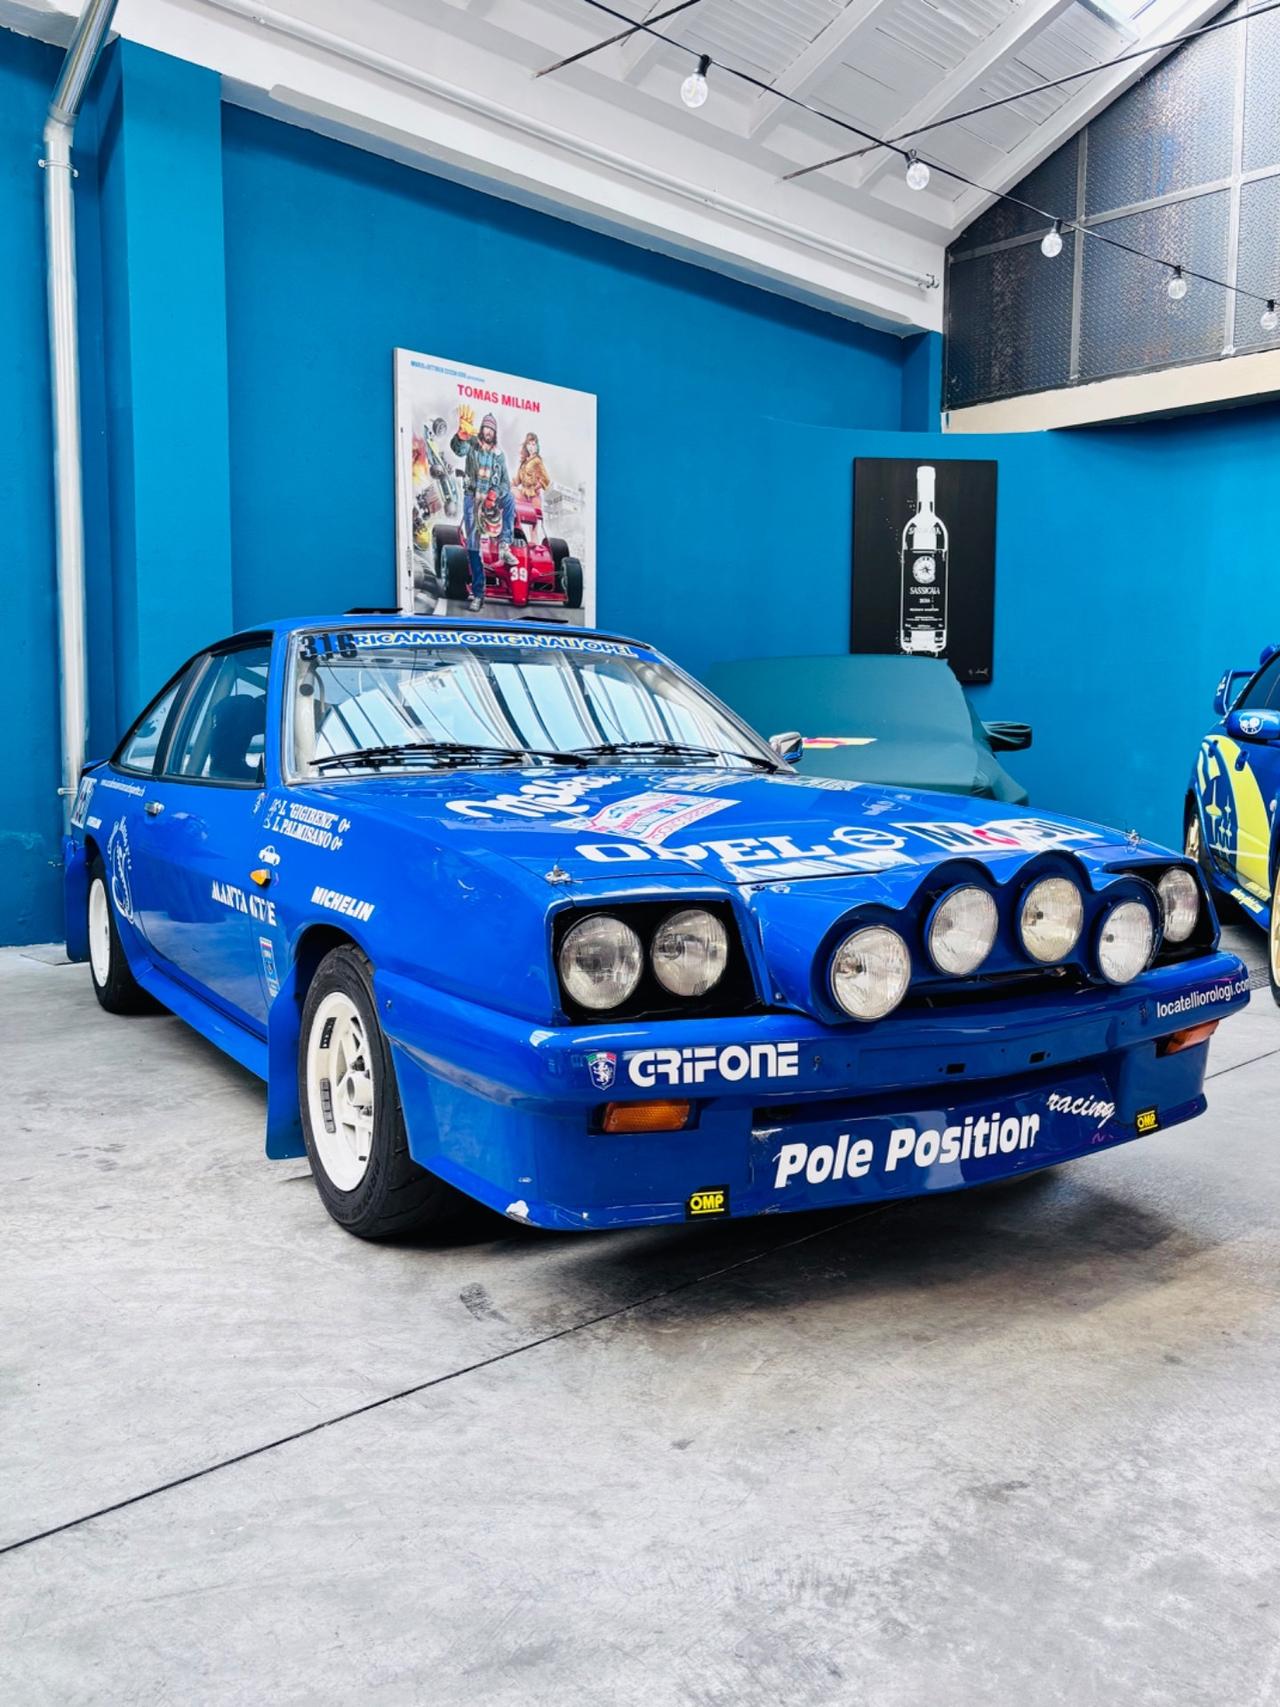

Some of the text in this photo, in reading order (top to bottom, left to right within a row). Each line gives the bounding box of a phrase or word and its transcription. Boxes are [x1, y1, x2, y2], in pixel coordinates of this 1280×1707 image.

[457, 383, 540, 413] TOMAS MILIAN
[510, 566, 528, 582] 39
[353, 631, 460, 647] RICAMBI
[575, 835, 836, 863] OPEL
[311, 886, 375, 922] MICHELIN
[628, 1042, 799, 1088] GRIFONE
[1048, 1091, 1115, 1128] racing
[1136, 1114, 1157, 1128] OMP
[773, 1112, 1040, 1189] Pole Position
[690, 1195, 724, 1211] OMP
